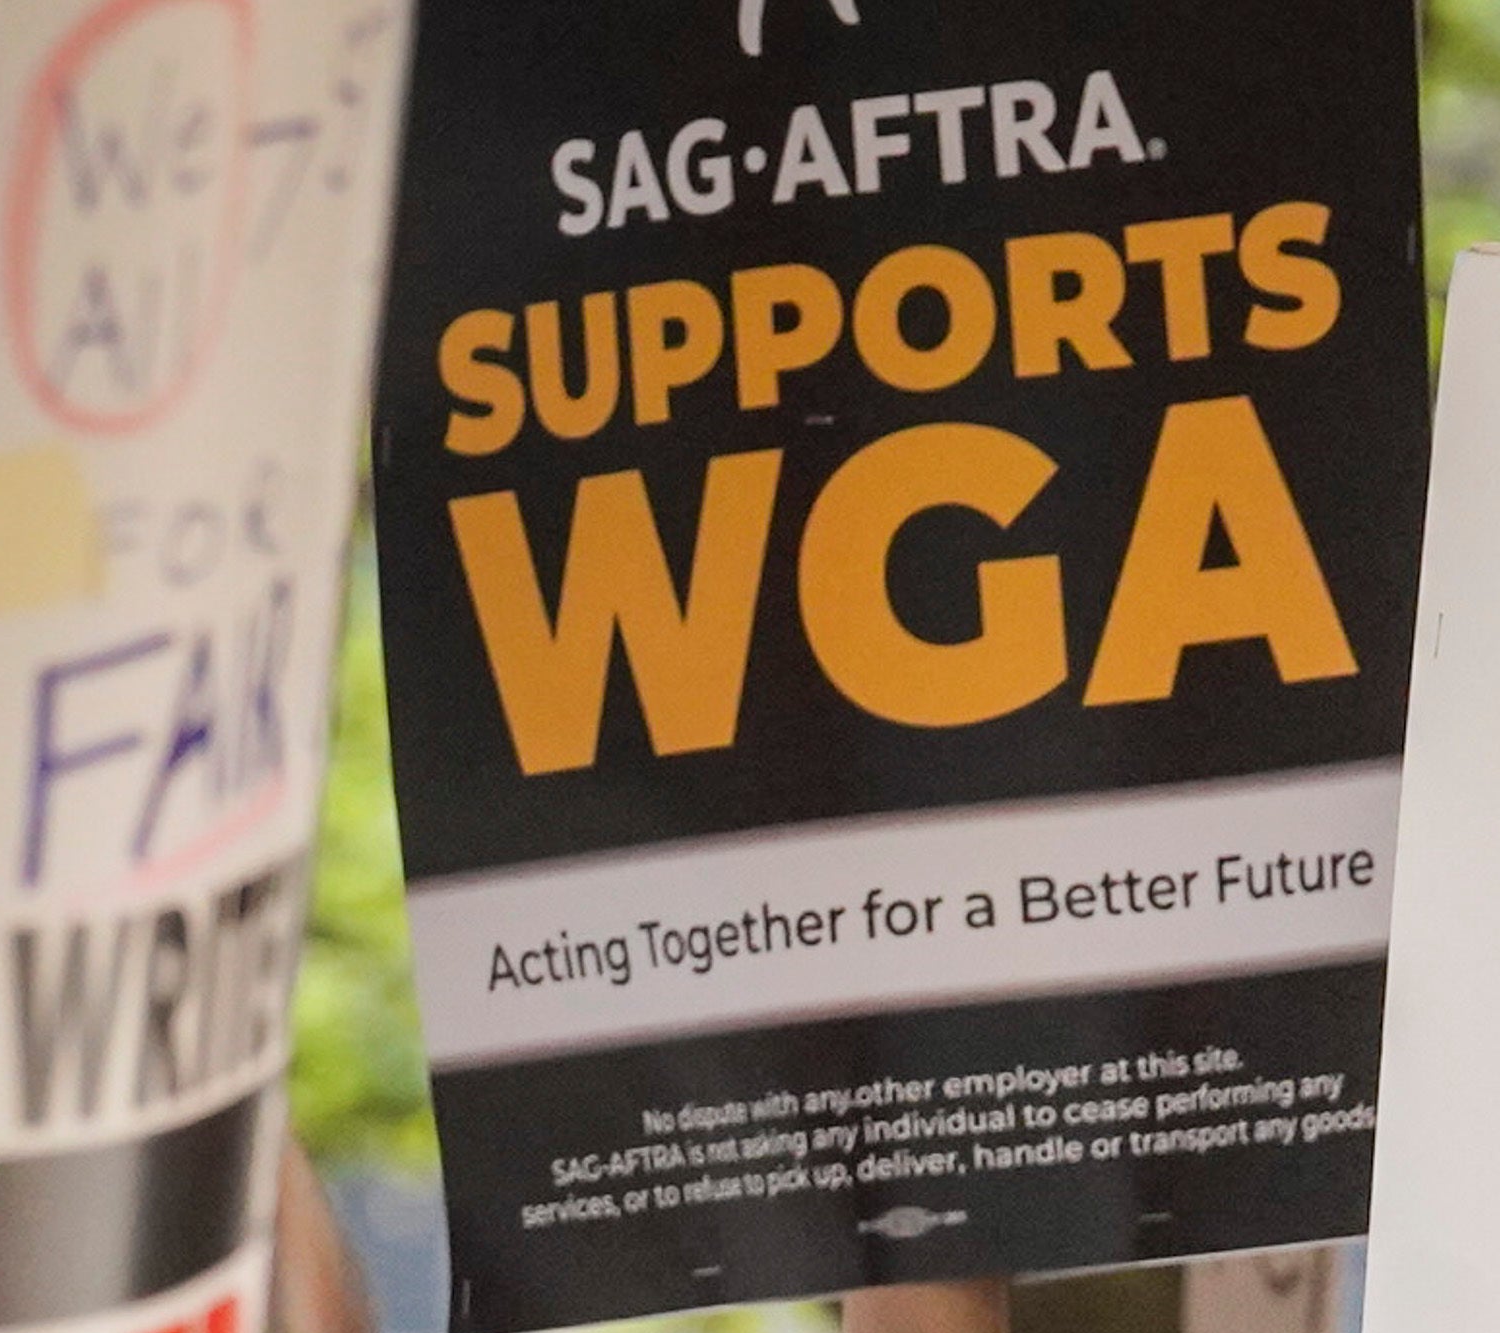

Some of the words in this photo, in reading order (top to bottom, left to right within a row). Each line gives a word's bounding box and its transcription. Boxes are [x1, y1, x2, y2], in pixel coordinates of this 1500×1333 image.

[437, 201, 1342, 458] SUPPORTS
[447, 395, 1360, 777] WGA
[488, 931, 632, 991] Acting
[638, 902, 846, 976] Together
[862, 889, 944, 941] for
[964, 893, 996, 931] a
[1019, 869, 1199, 924] Better
[1216, 848, 1376, 903] Future
[551, 1143, 686, 1187] SAG-AFTRA
[687, 1140, 705, 1165] is
[812, 1124, 858, 1152] any
[864, 1103, 1015, 1143] individual
[1022, 1103, 1056, 1129] to
[1063, 1095, 1149, 1125] cease
[1155, 1077, 1296, 1121] performing
[1299, 1072, 1345, 1103] any
[642, 1108, 675, 1136] No
[676, 1100, 748, 1134] dispute
[749, 1090, 800, 1118] with
[804, 1087, 852, 1116] any
[853, 1075, 936, 1107] other
[943, 1062, 1093, 1099] employer
[1099, 1059, 1131, 1086] at
[1137, 1049, 1190, 1081] this
[1193, 1045, 1244, 1074] site.
[623, 1189, 653, 1213] or
[654, 1184, 681, 1209] to
[856, 1148, 967, 1183] deliver,
[973, 1137, 1083, 1171] handle
[1090, 1134, 1122, 1161] or
[1129, 1119, 1251, 1157] transport
[1252, 1117, 1298, 1145] any
